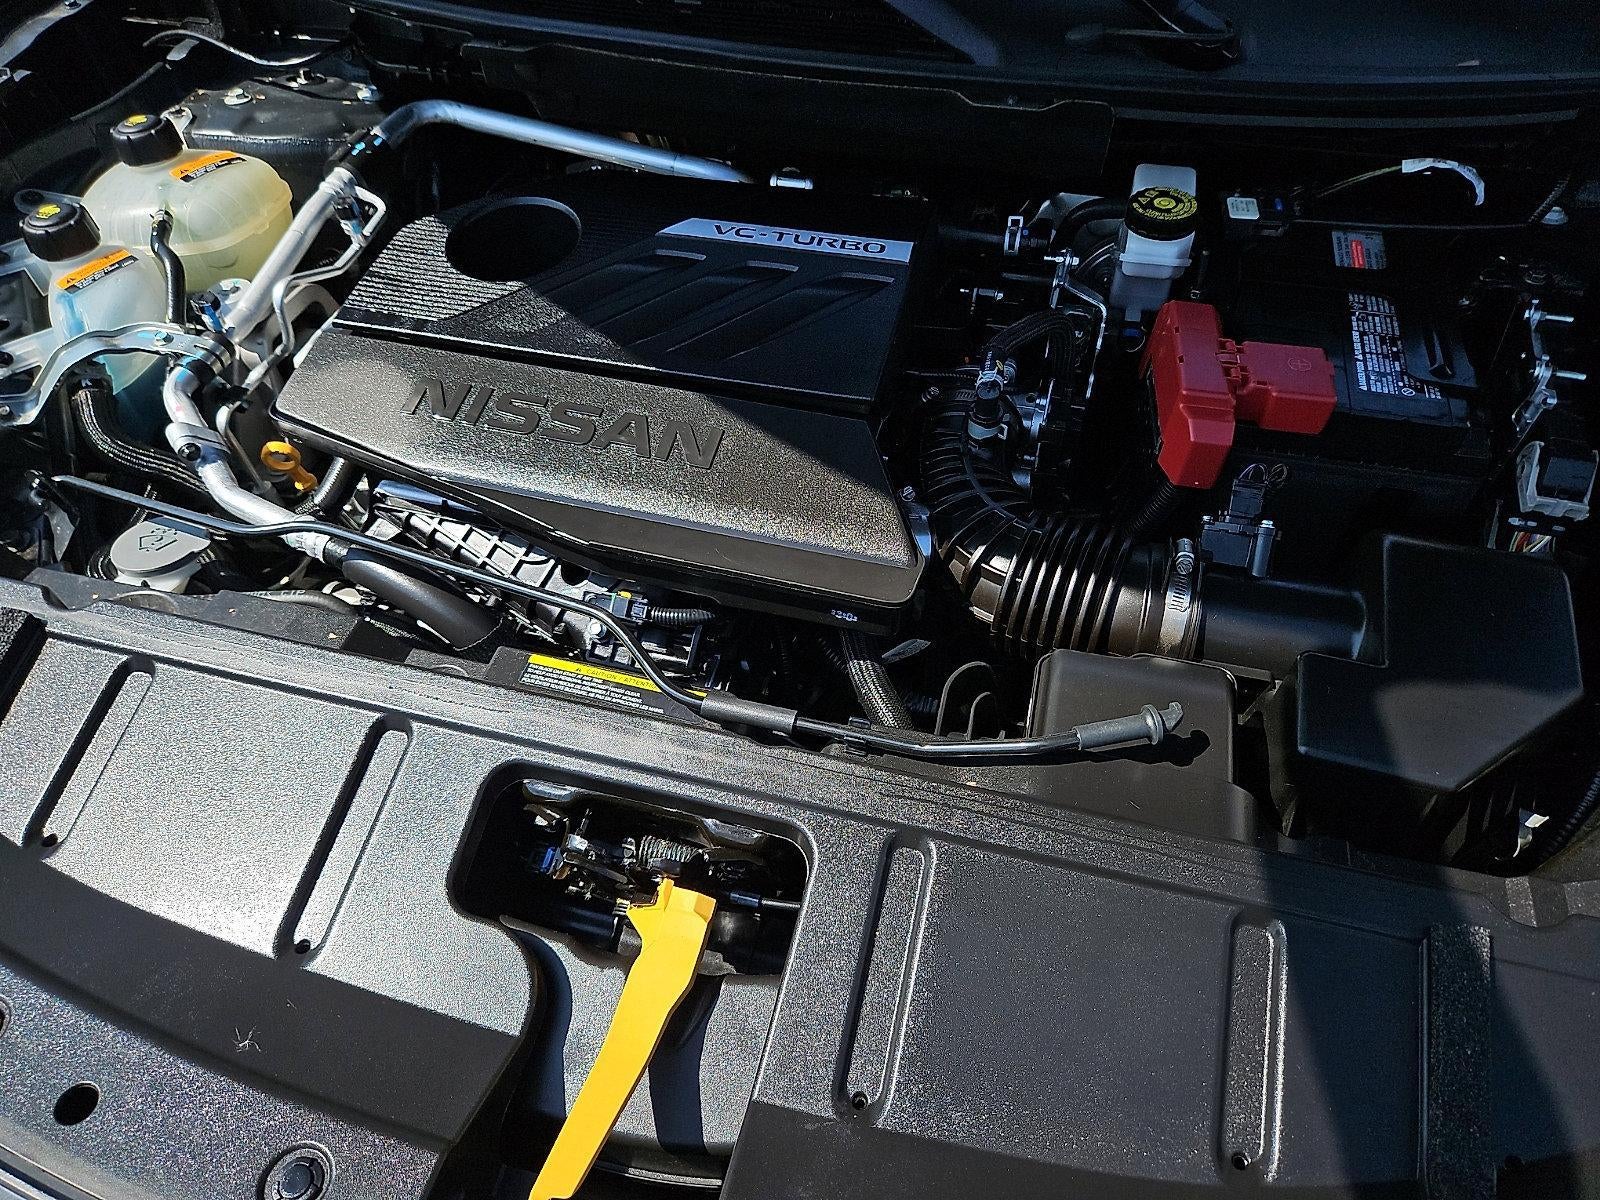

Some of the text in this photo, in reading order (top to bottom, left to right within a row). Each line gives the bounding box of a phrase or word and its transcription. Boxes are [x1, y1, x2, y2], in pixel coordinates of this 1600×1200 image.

[714, 224, 886, 254] VC-TURBO
[402, 378, 725, 469] NISSAN
[623, 677, 656, 688] ATTENTIO
